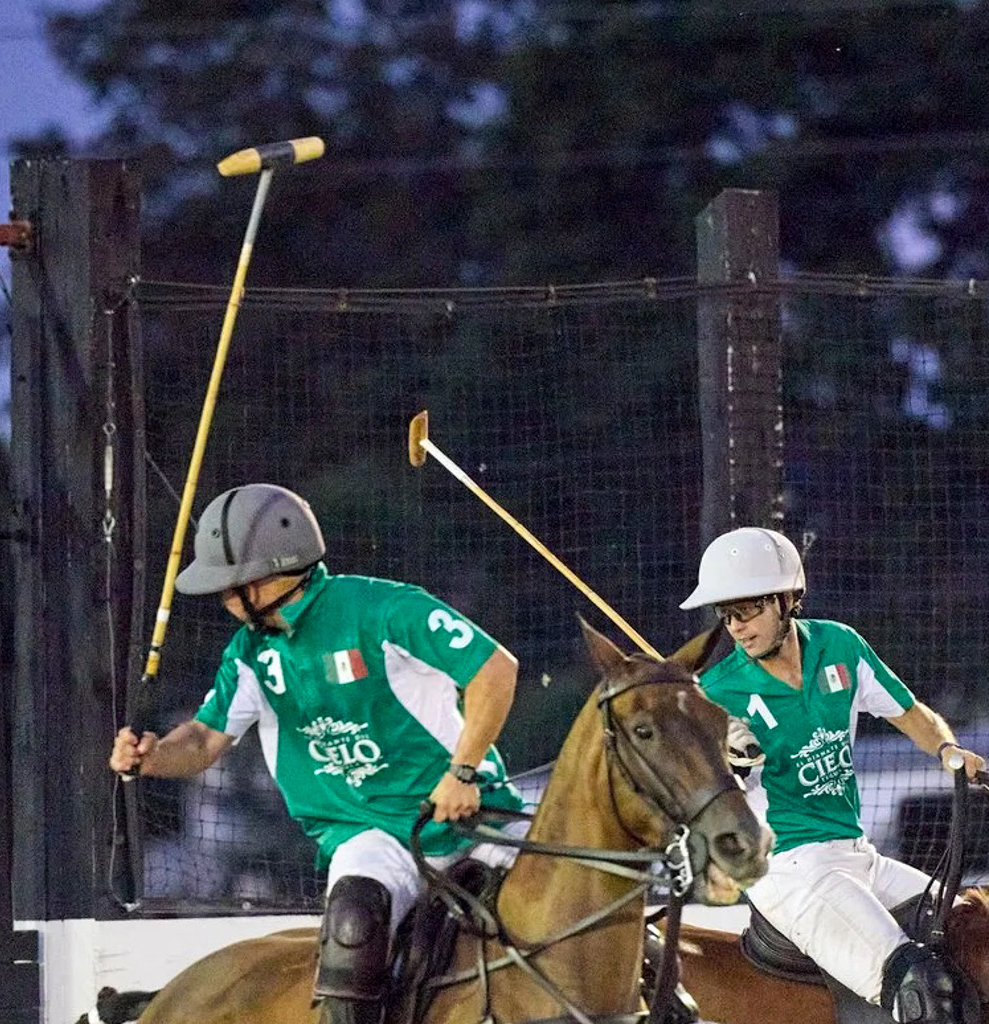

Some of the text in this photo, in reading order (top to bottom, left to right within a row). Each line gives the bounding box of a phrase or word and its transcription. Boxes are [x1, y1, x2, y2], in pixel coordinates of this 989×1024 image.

[428, 608, 474, 649] 3
[257, 648, 287, 695] 3
[746, 693, 779, 730] 1
